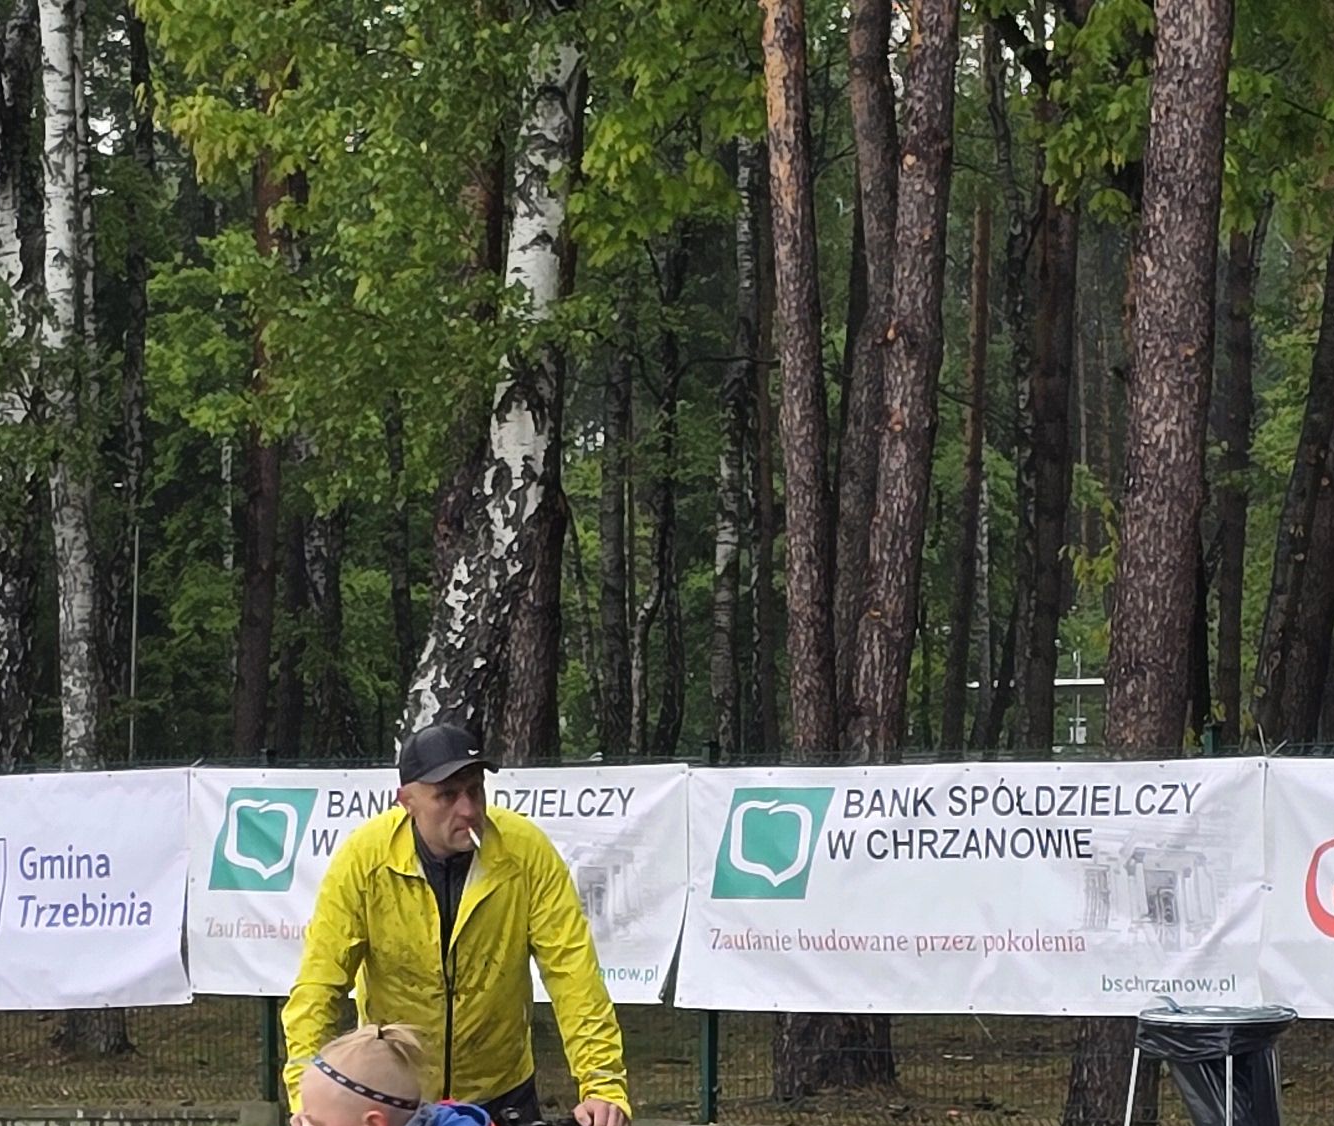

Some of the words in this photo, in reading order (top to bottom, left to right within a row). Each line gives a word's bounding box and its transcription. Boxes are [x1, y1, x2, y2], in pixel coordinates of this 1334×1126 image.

[494, 787, 635, 817] DZIELCZY
[843, 787, 936, 819] BANK
[948, 778, 1201, 818] SPÓŁDZIELCZY
[312, 829, 338, 857] W
[827, 829, 855, 861] W
[866, 828, 1094, 861] CHRZANOWIE
[19, 845, 111, 880] Gmina
[18, 892, 153, 928] Trzebinia
[205, 917, 278, 940] Zaufanie
[710, 928, 793, 951] Zaufanie
[798, 928, 908, 952] budowane
[916, 935, 976, 958] przez
[984, 928, 1086, 958] pokolenia
[1102, 974, 1236, 996] bschrzanow.pl
